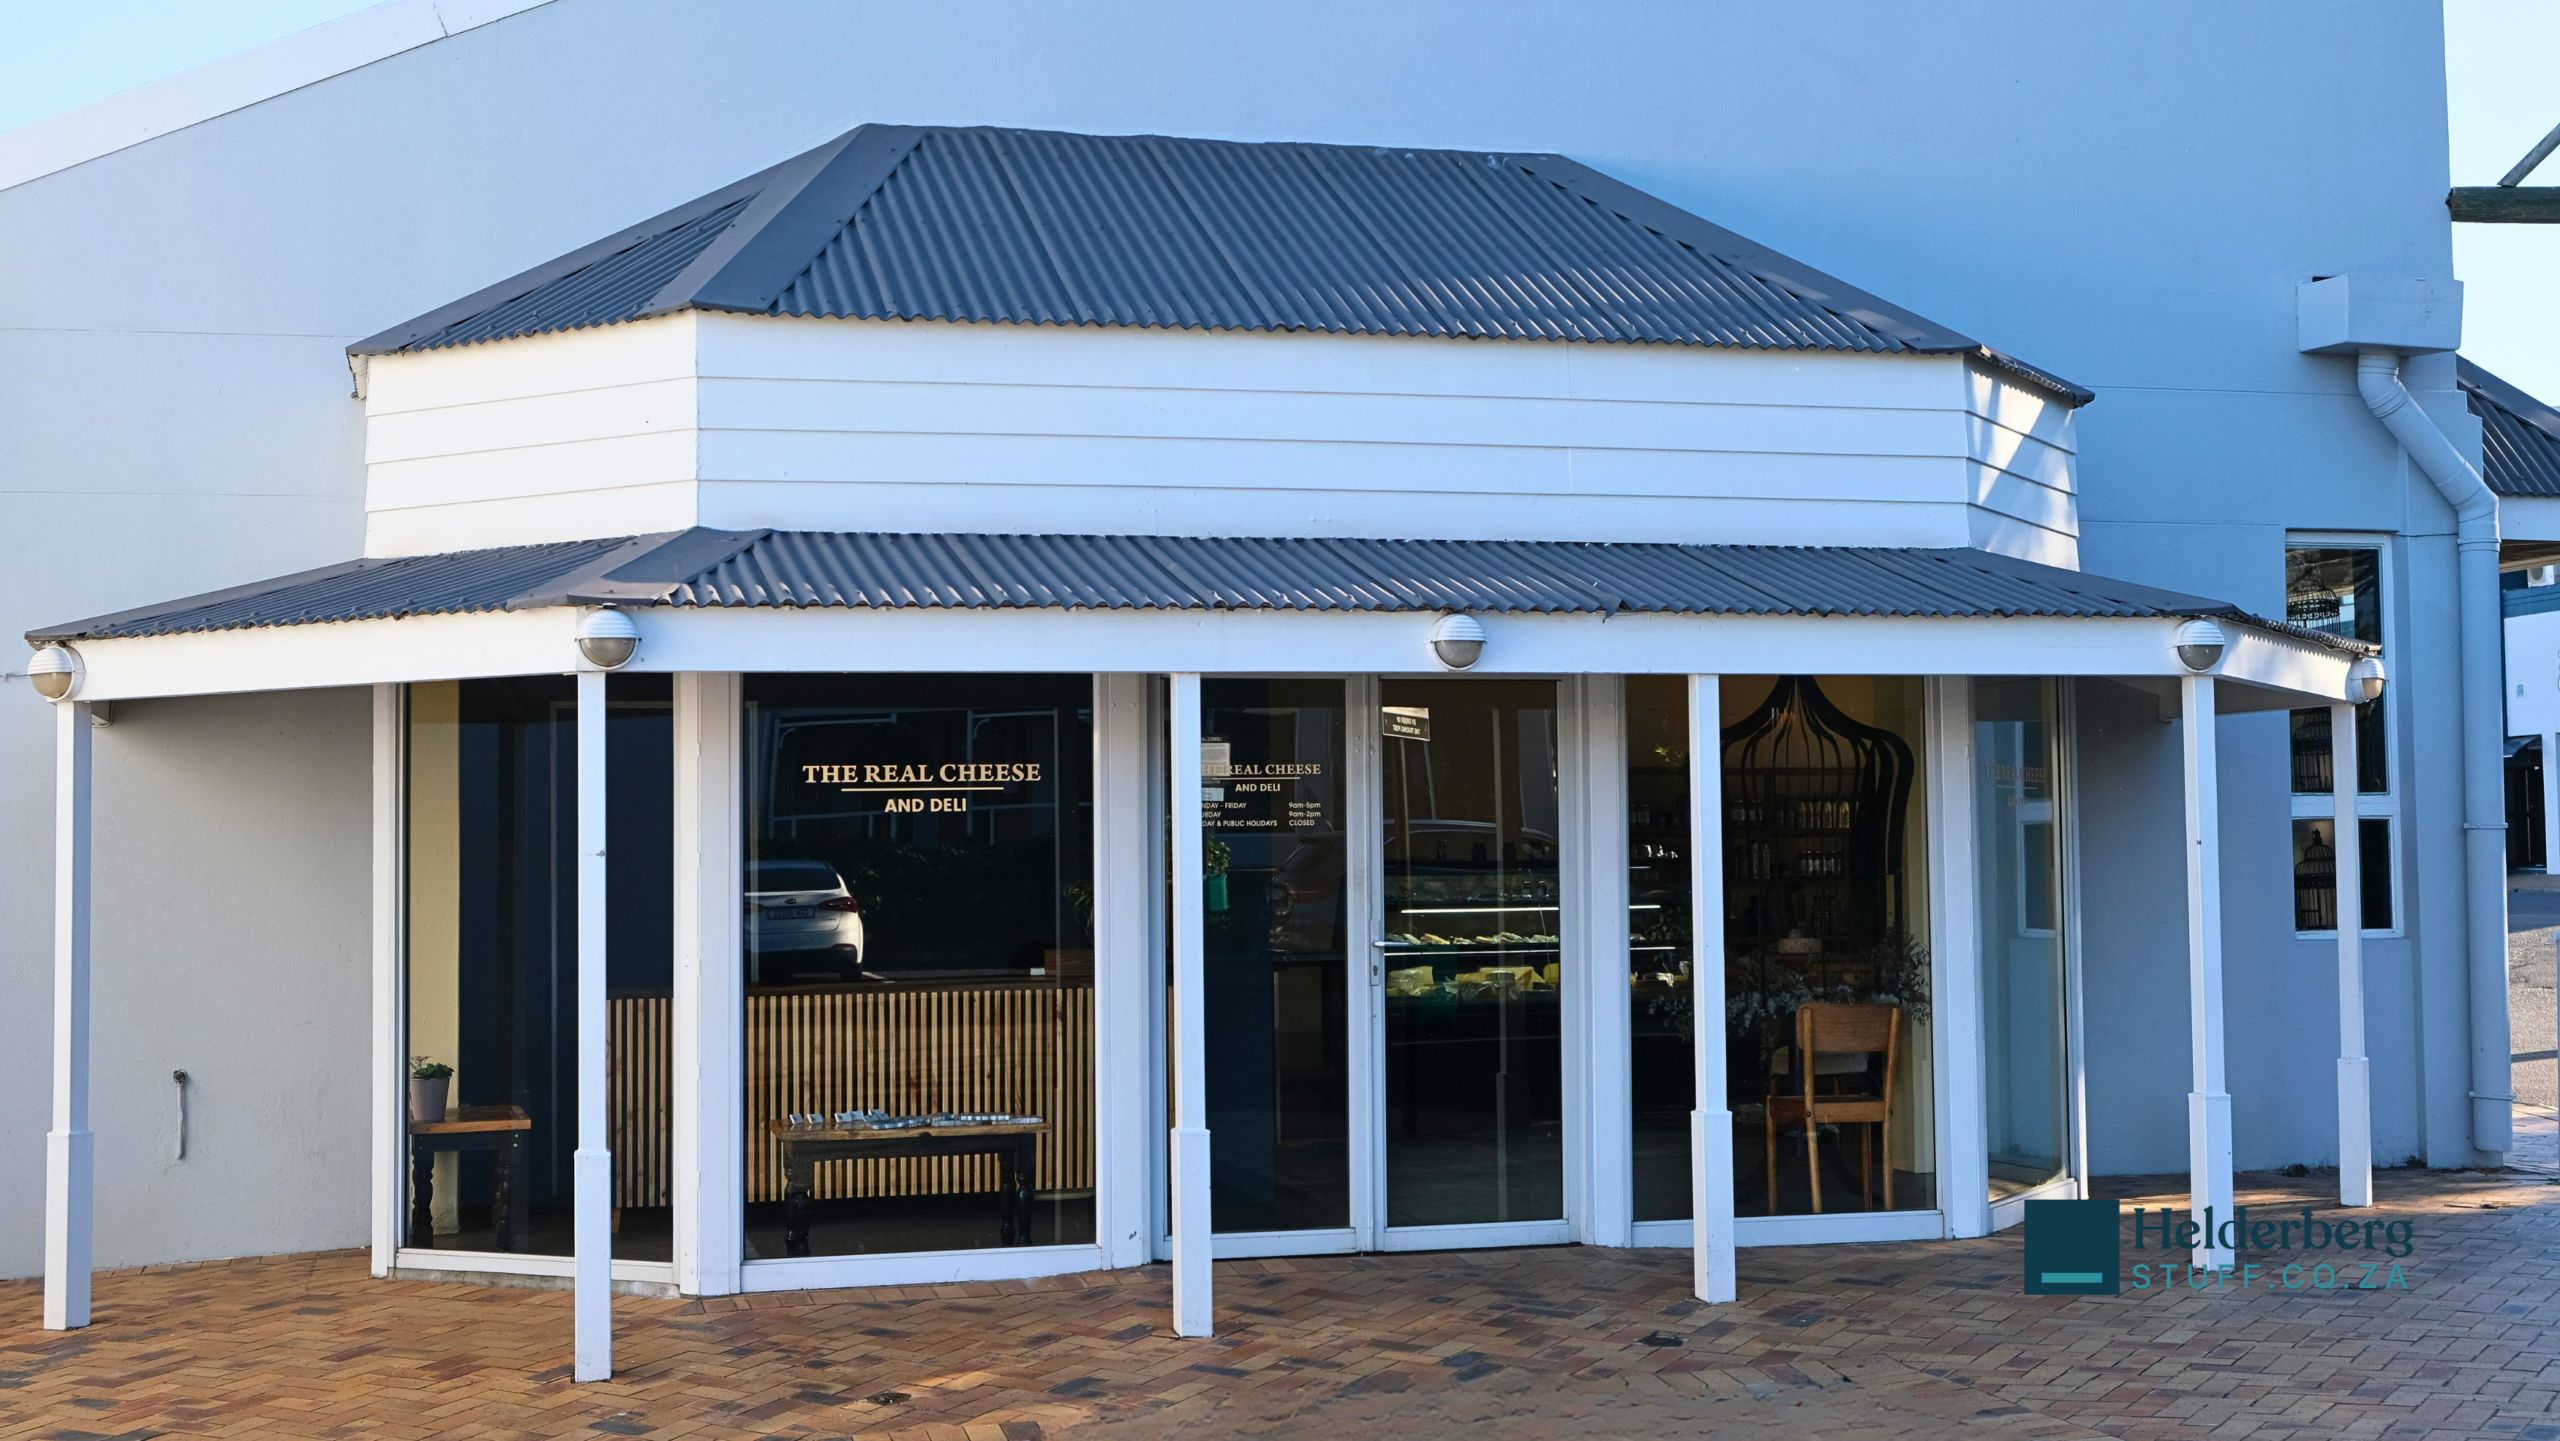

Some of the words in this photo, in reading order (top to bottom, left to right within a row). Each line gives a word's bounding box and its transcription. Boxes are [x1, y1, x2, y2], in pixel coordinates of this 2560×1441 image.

[802, 765, 858, 783] THE
[863, 764, 934, 783] REAL
[939, 763, 1042, 783] CHEESE
[1202, 764, 1221, 775] HE
[1223, 764, 1261, 775] REAL
[1265, 764, 1321, 775] CHEESE
[1235, 783, 1257, 792] AND
[1260, 783, 1281, 792] DELI
[885, 798, 925, 813] AND
[930, 798, 967, 812] DELI
[1288, 802, 1321, 810] 9am-5pm
[1288, 810, 1321, 818] 9am-2pm
[1288, 819, 1315, 827] CLOSED
